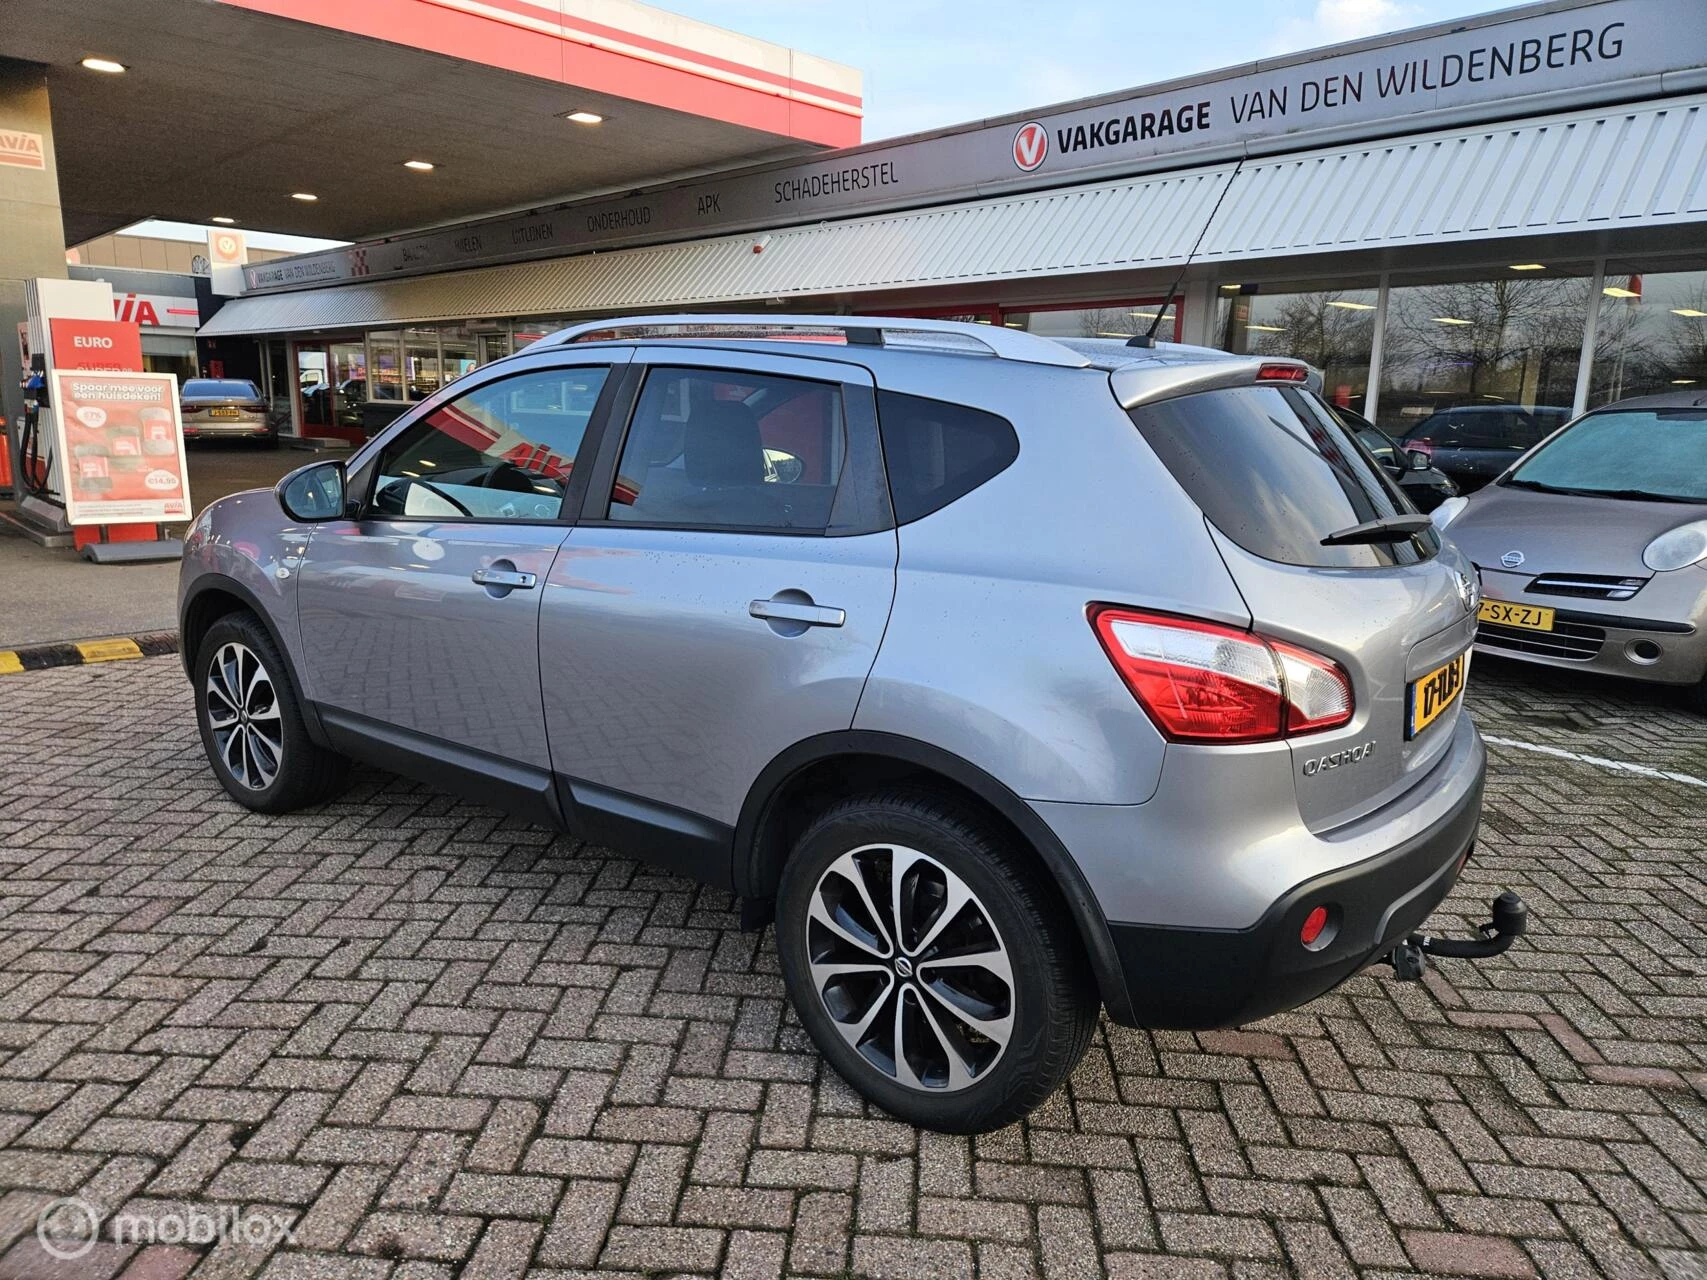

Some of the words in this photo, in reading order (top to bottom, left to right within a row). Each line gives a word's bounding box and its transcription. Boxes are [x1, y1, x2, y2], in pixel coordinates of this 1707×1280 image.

[1057, 101, 1211, 154] VAKGARAGE
[1230, 86, 1288, 124] VAN
[1300, 71, 1363, 113] DEN
[1376, 22, 1625, 99] WILDENBERG
[774, 161, 898, 204] SCHADEHERSTEL
[697, 193, 721, 216] APK
[586, 206, 651, 233] ONDERHOUD
[73, 336, 113, 349] EURO
[72, 382, 107, 393] Spaar
[137, 384, 164, 394] voor
[74, 391, 96, 400] een
[98, 391, 161, 401] huisdeken!
